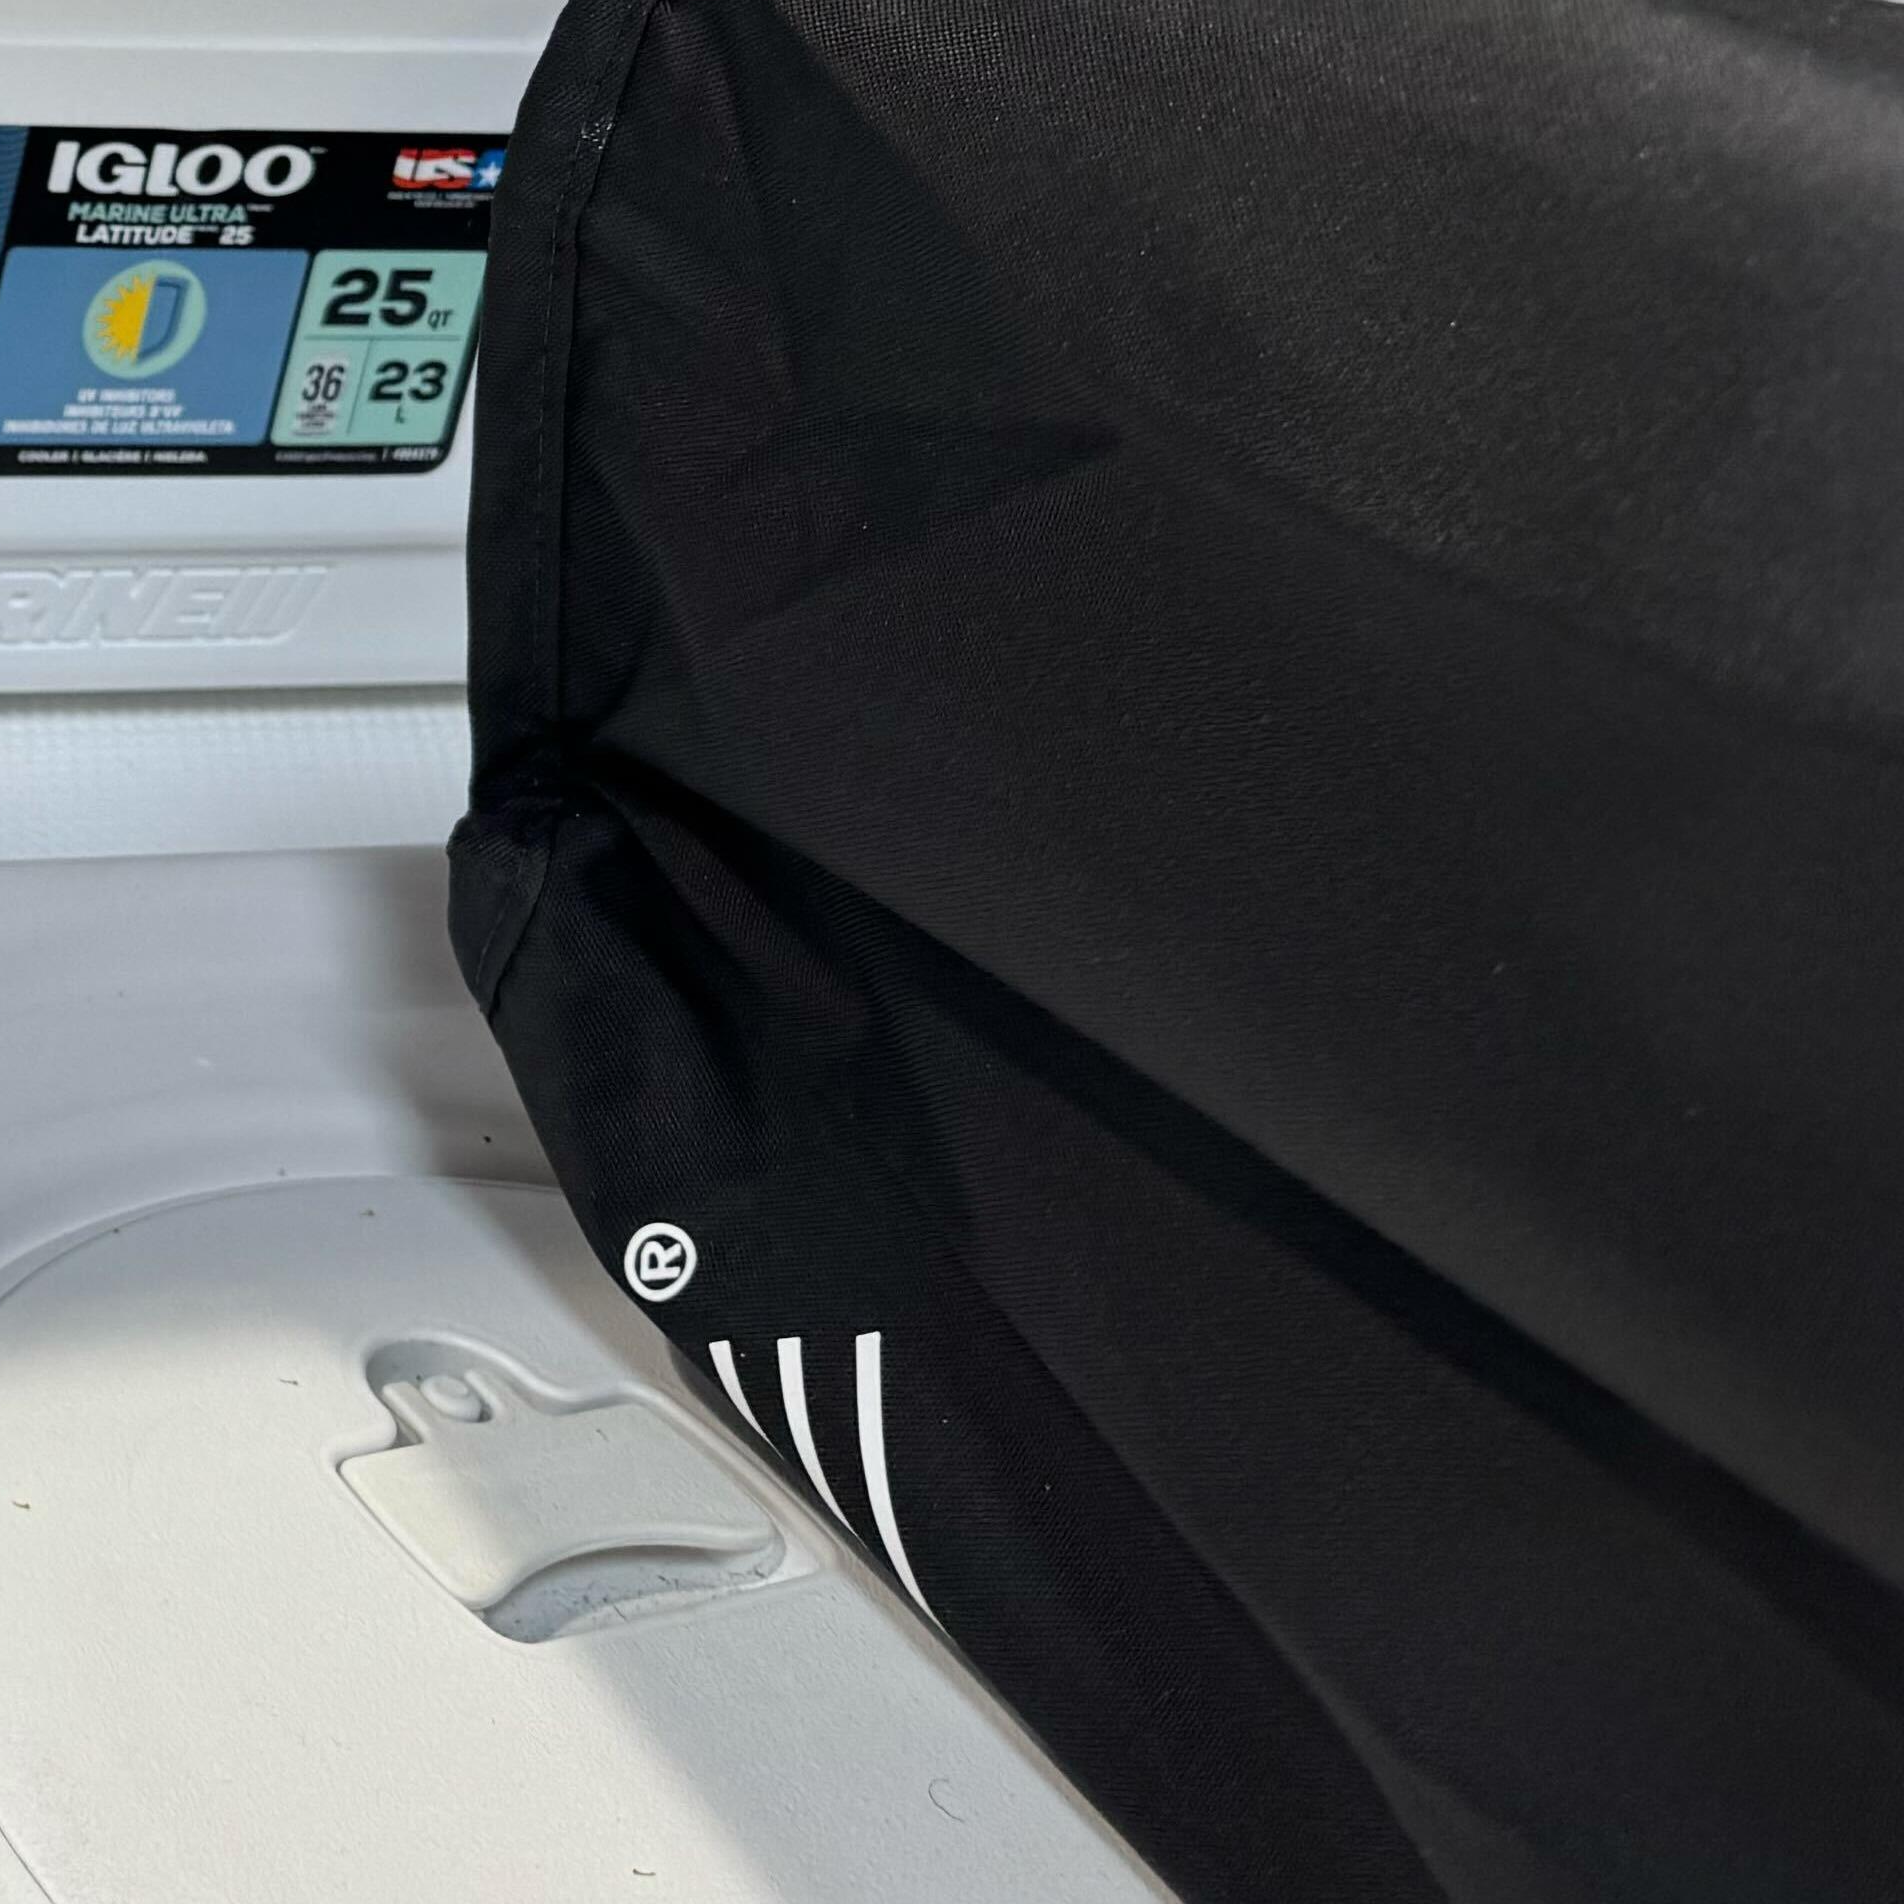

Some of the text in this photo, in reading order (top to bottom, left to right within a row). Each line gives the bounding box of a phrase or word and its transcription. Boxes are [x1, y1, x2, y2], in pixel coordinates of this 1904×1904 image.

[48, 141, 315, 196] IGLOO
[67, 202, 167, 223] MARINE
[219, 225, 254, 246] 25
[321, 268, 452, 330] 25 QT
[302, 364, 345, 403] 36
[368, 360, 448, 402] 23
